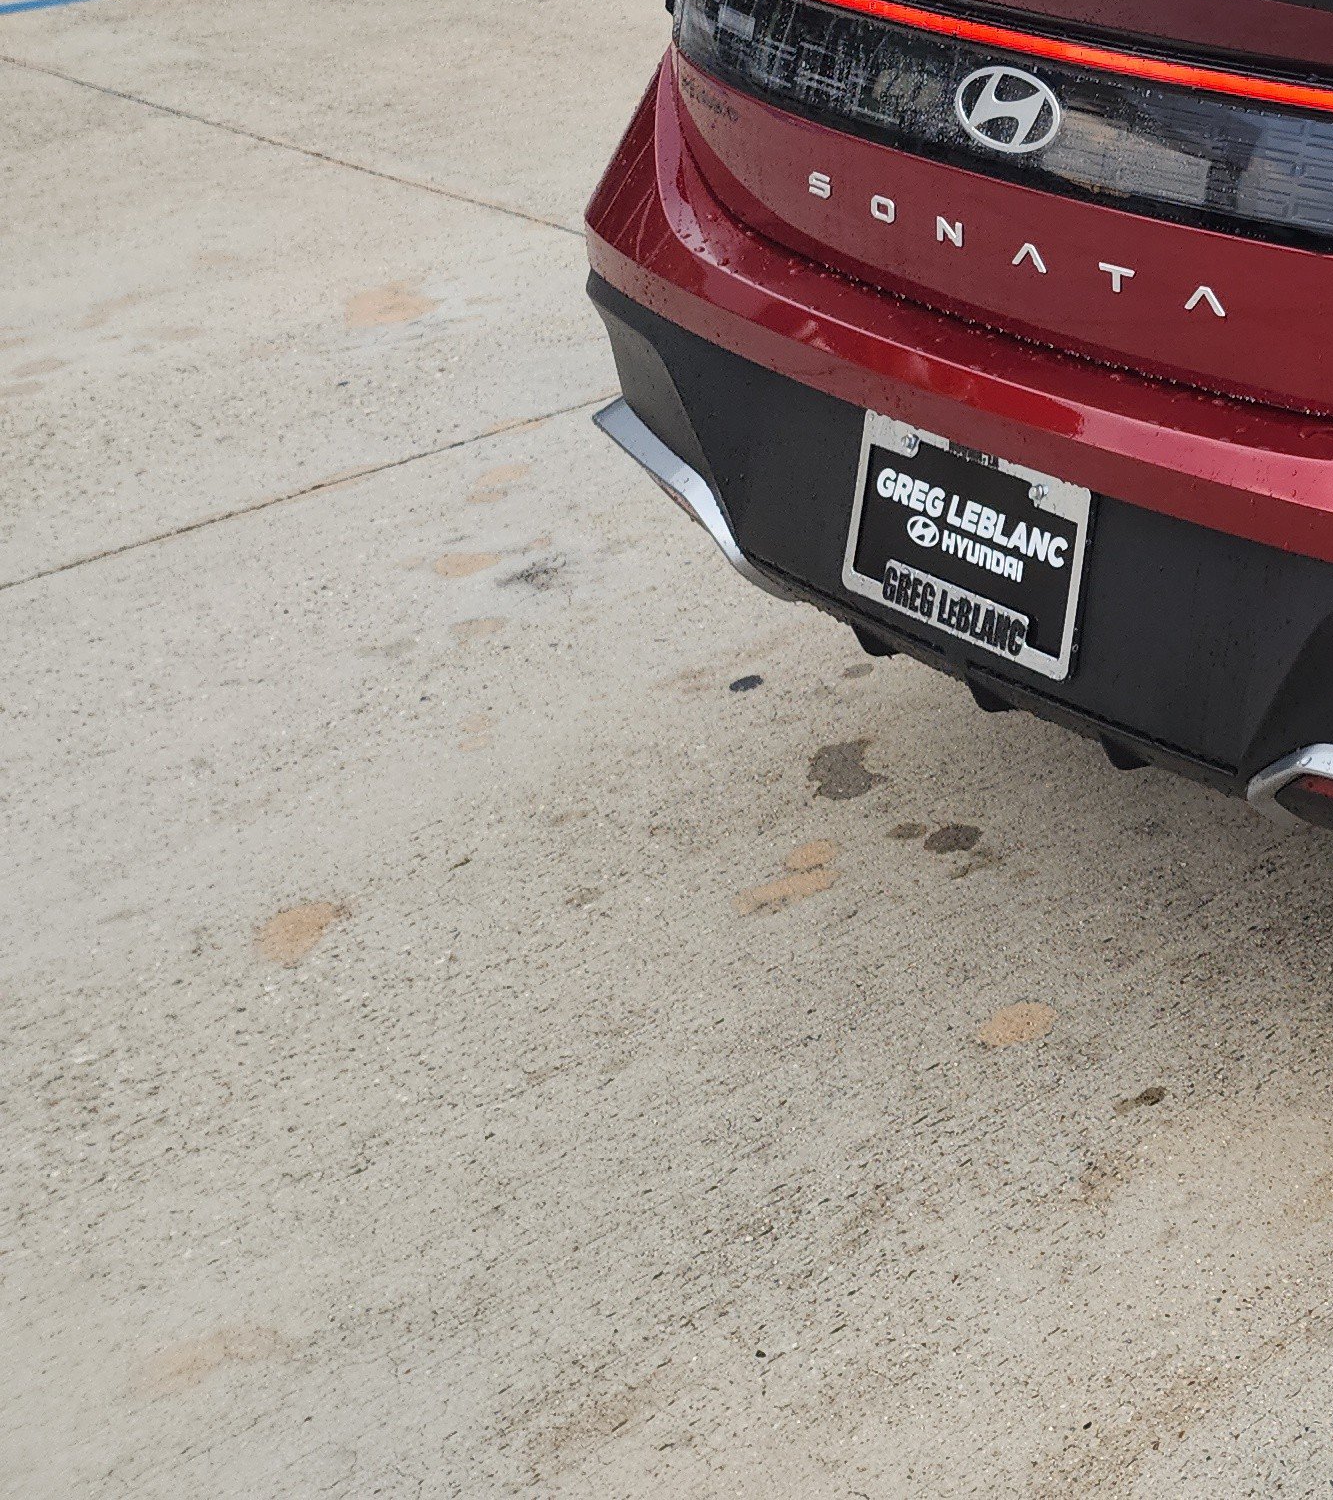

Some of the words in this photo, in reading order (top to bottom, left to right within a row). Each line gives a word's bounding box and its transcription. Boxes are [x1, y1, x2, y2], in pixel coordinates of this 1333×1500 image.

[808, 170, 1227, 317] SONATA
[876, 467, 945, 518] GREG
[946, 494, 1068, 568] LEBLANC
[882, 565, 936, 619] GREG
[941, 530, 1024, 583] HYUNDAI
